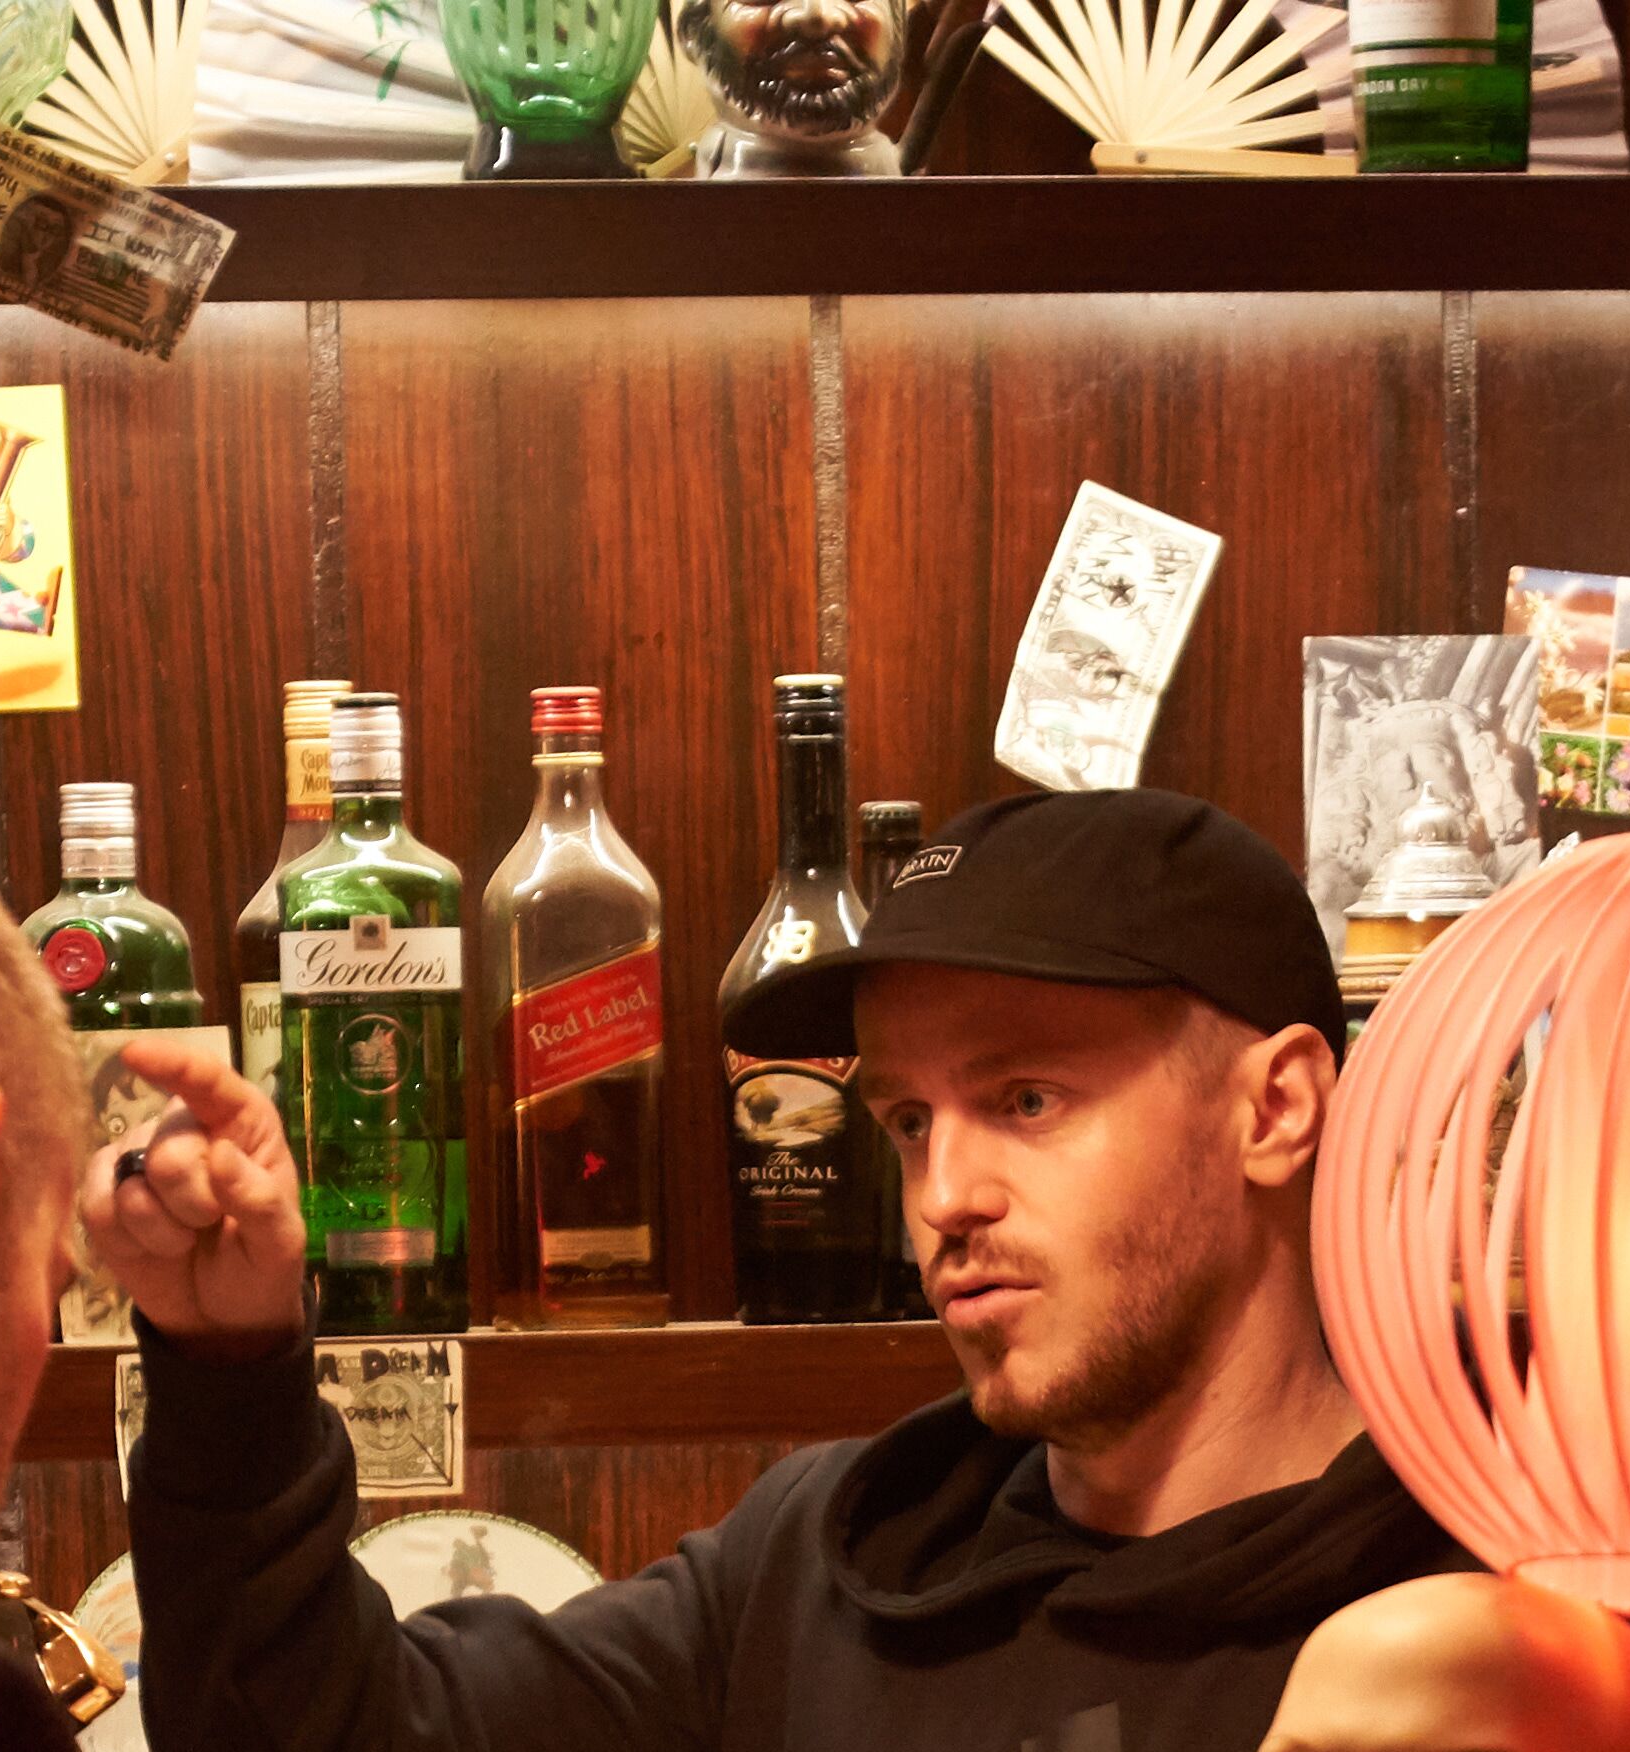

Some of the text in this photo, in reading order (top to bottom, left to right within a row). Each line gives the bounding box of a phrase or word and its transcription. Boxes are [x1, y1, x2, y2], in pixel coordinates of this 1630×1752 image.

[82, 221, 124, 244] IT
[295, 938, 447, 988] Gordon's
[528, 1012, 582, 1050] Red
[583, 985, 649, 1030] Label
[767, 1152, 801, 1166] The
[739, 1166, 838, 1181] ORIGINAL
